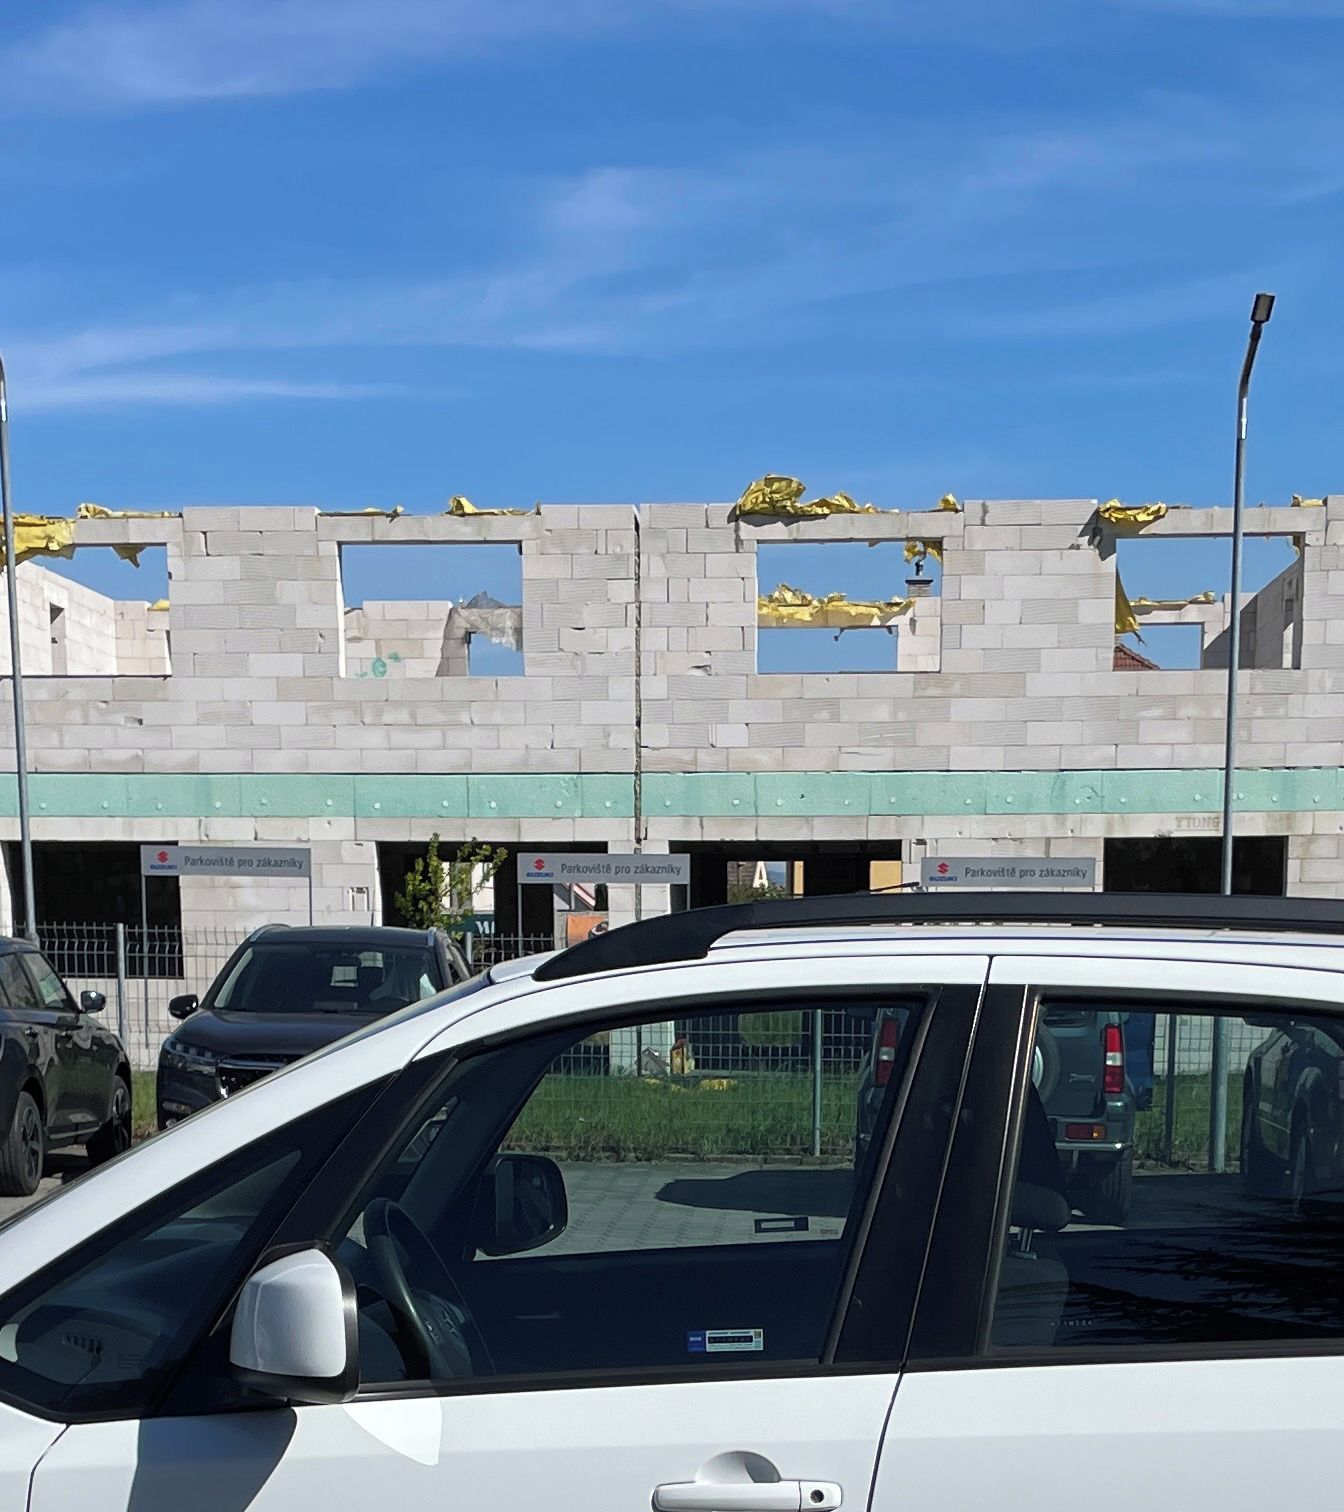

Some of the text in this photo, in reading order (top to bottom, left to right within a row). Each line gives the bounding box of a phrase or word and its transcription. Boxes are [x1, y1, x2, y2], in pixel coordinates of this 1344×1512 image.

[184, 855, 304, 870] Parkoviště pro zákazníky
[560, 863, 681, 876] Parkoviště pro zákazníky
[964, 866, 1087, 879] Parkoviště pro zákazníky
